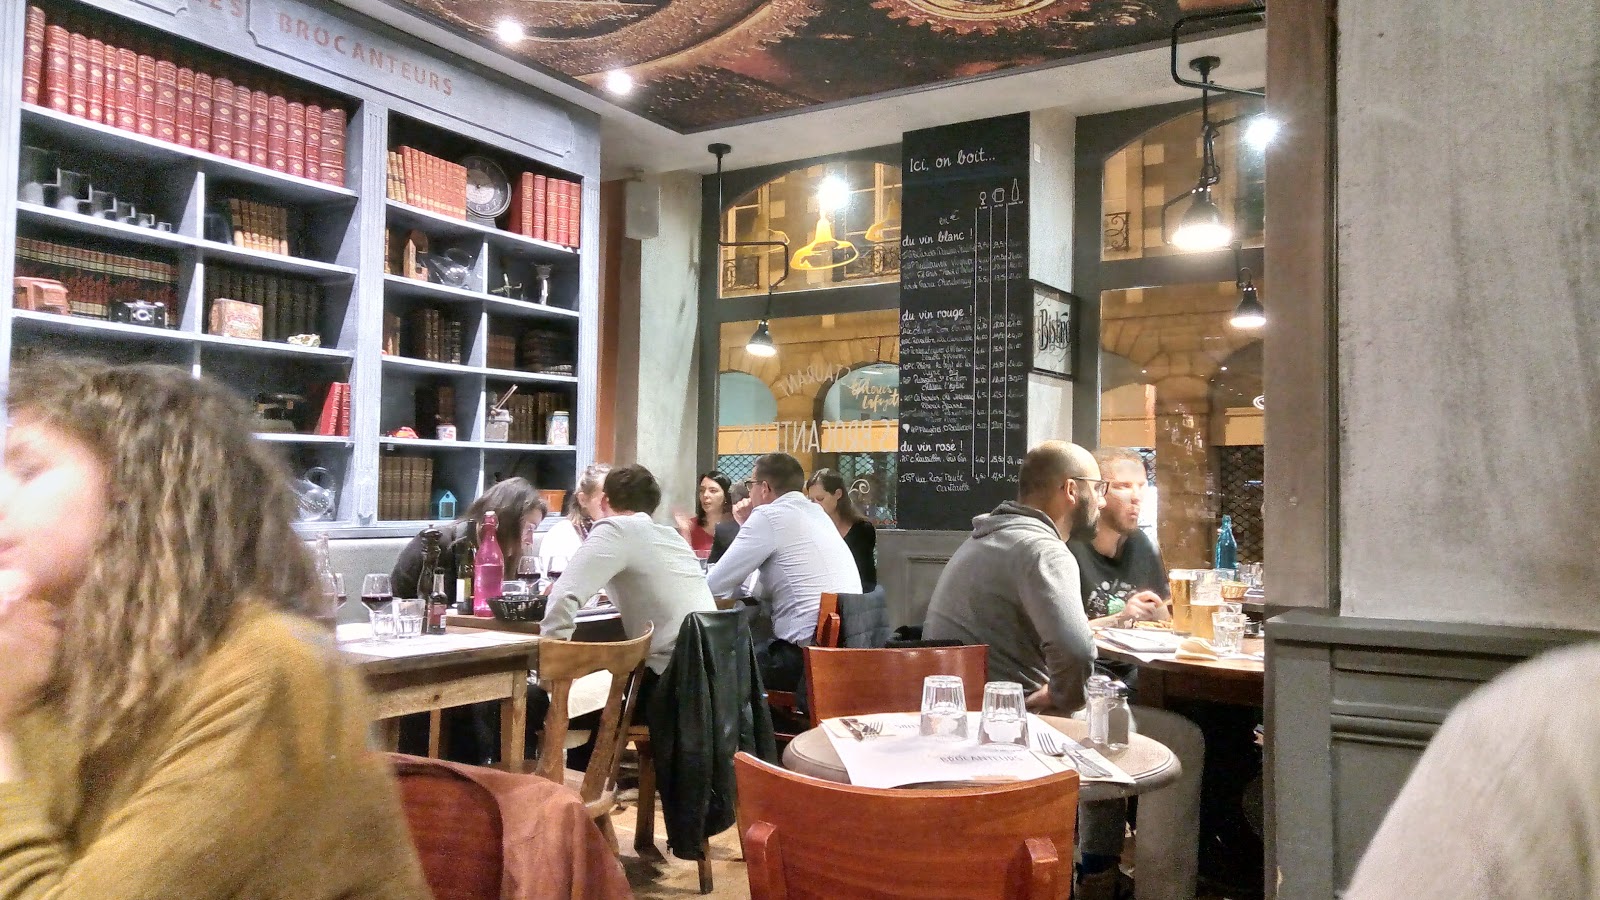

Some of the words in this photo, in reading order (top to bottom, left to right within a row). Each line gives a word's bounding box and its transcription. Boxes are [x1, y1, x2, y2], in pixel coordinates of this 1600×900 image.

[279, 12, 453, 97] BROCANTEURS
[909, 158, 929, 172] Ici,
[935, 156, 952, 168] on
[956, 147, 995, 165] boit...
[901, 234, 915, 247] du
[919, 235, 933, 245] vin
[937, 230, 965, 243] blanc
[901, 309, 915, 321] du
[918, 310, 933, 320] vin
[937, 308, 964, 321] rouge
[900, 440, 913, 452] du
[917, 441, 932, 452] vin
[935, 439, 957, 451] rosé
